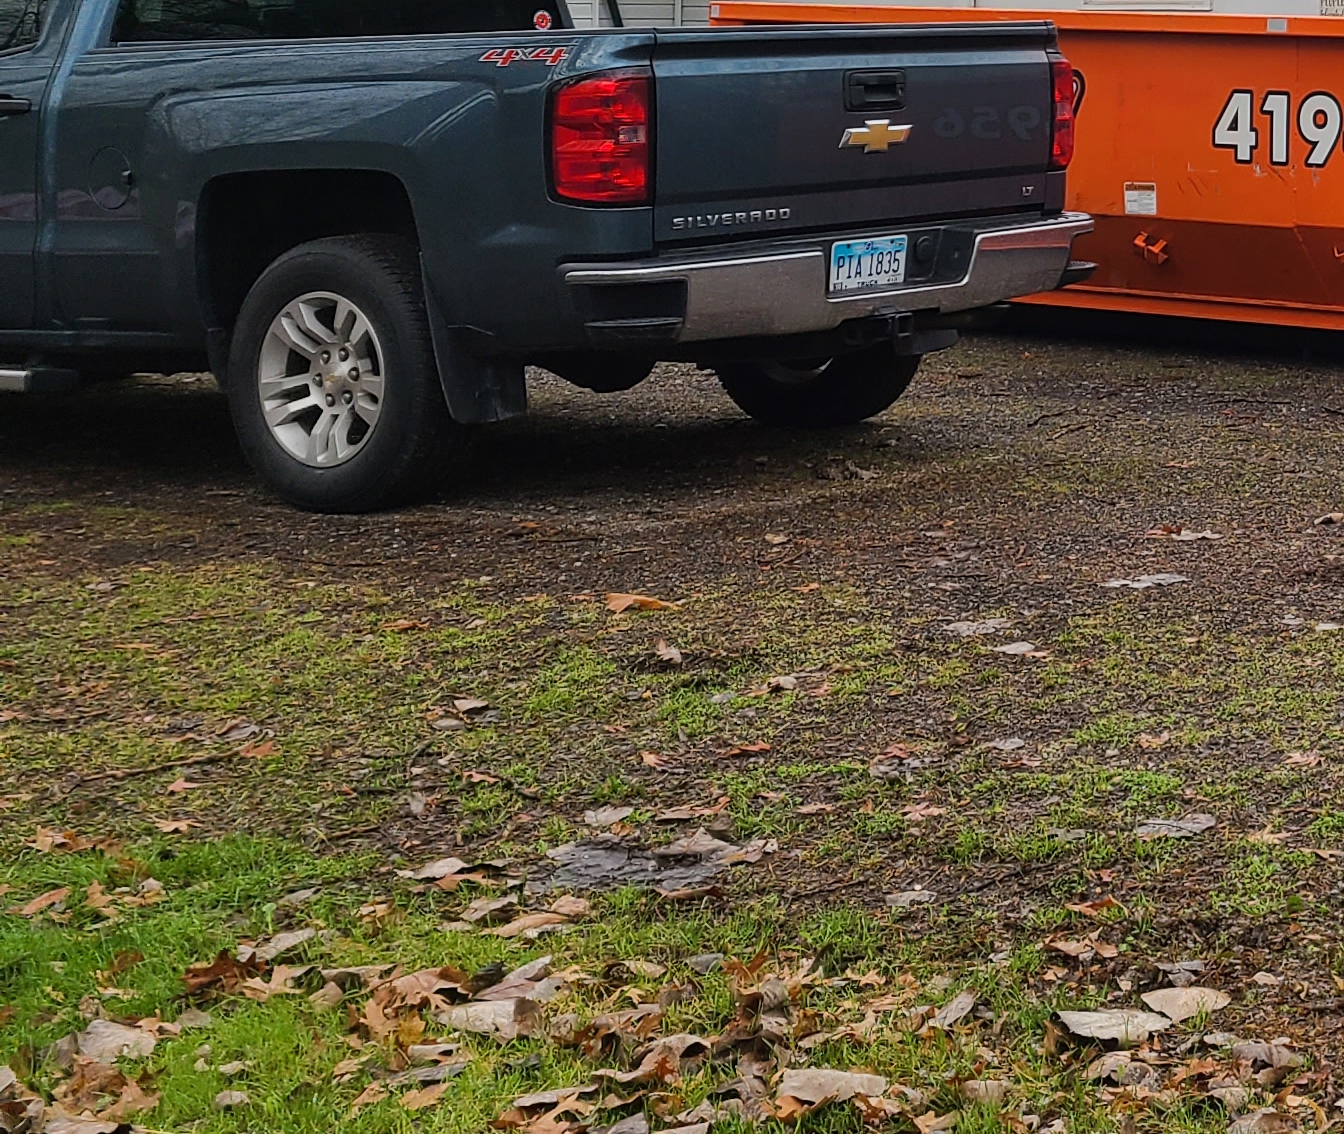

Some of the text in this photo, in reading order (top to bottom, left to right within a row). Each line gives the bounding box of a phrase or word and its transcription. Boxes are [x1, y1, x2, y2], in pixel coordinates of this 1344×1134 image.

[1022, 185, 1035, 196] LT
[671, 207, 791, 230] SILVERADO
[836, 248, 902, 281] PIA 1835
